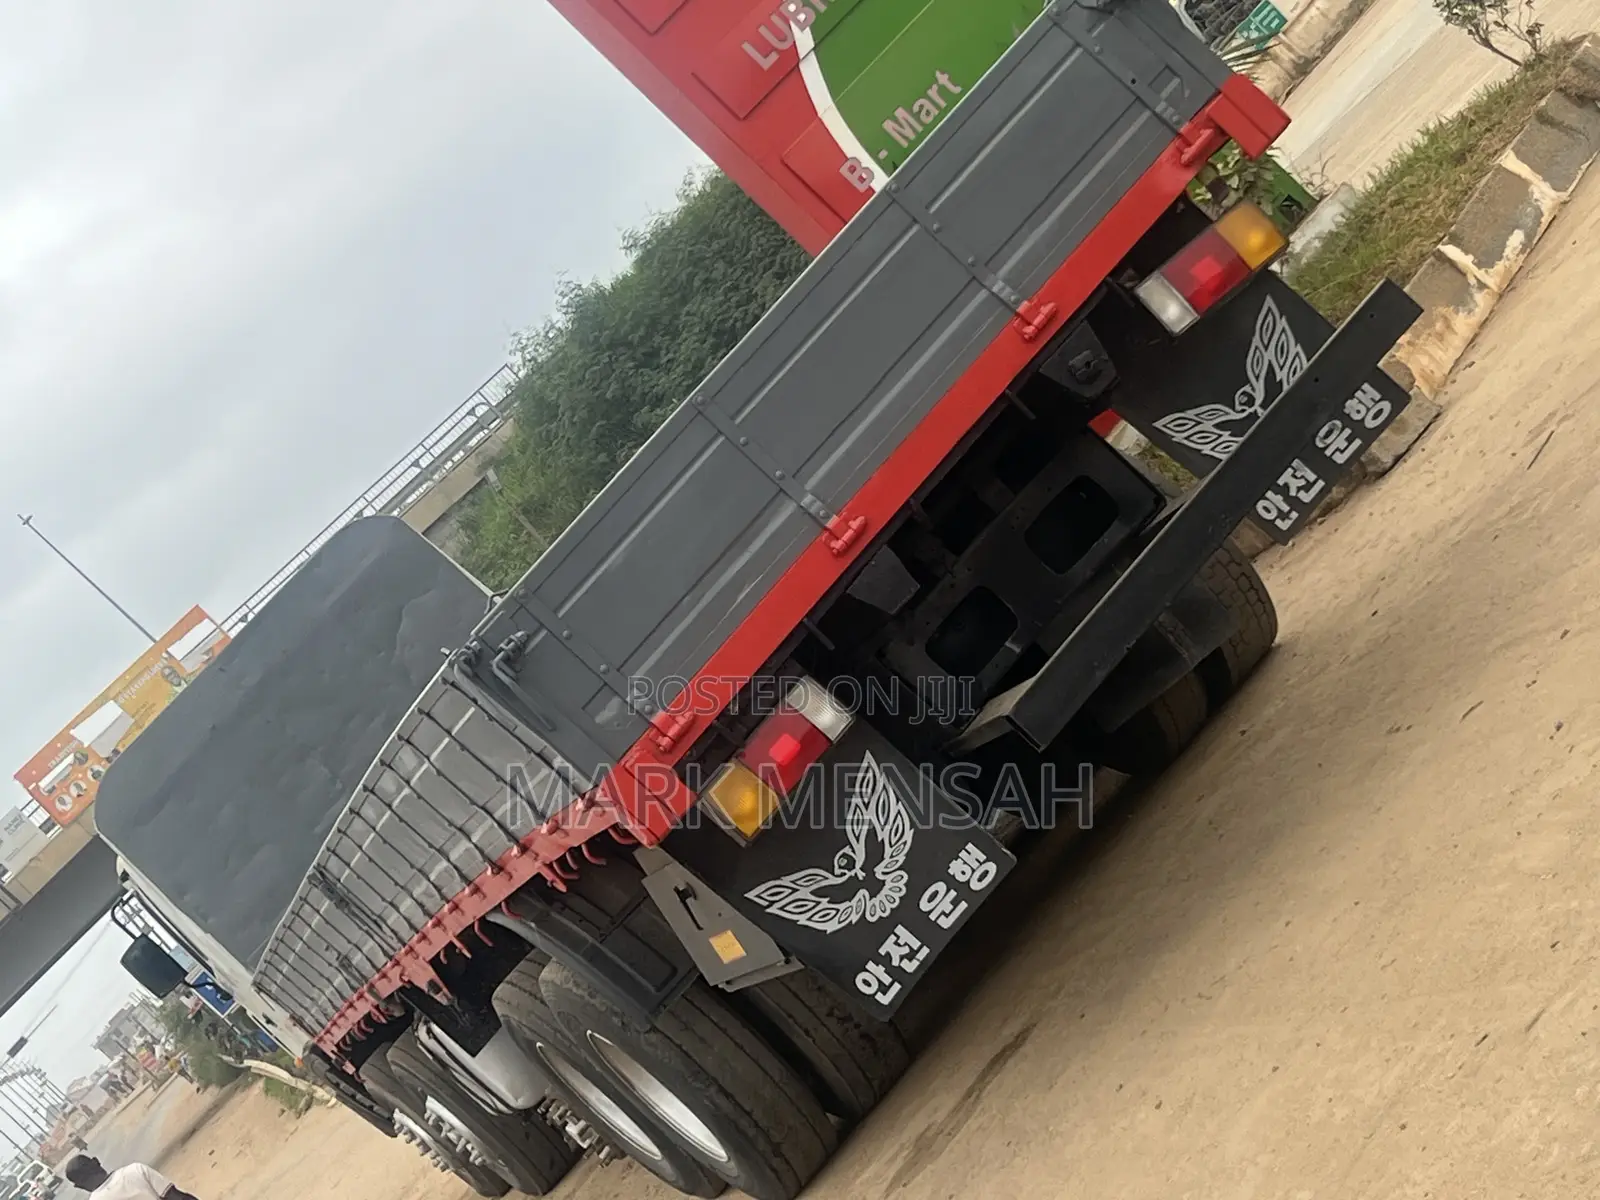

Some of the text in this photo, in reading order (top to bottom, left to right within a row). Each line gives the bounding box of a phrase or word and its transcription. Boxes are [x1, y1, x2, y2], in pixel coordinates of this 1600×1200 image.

[839, 156, 875, 193] B
[881, 69, 962, 148] Mart
[1255, 382, 1392, 531] 안전 운행
[855, 842, 997, 1005] 안전 운행
